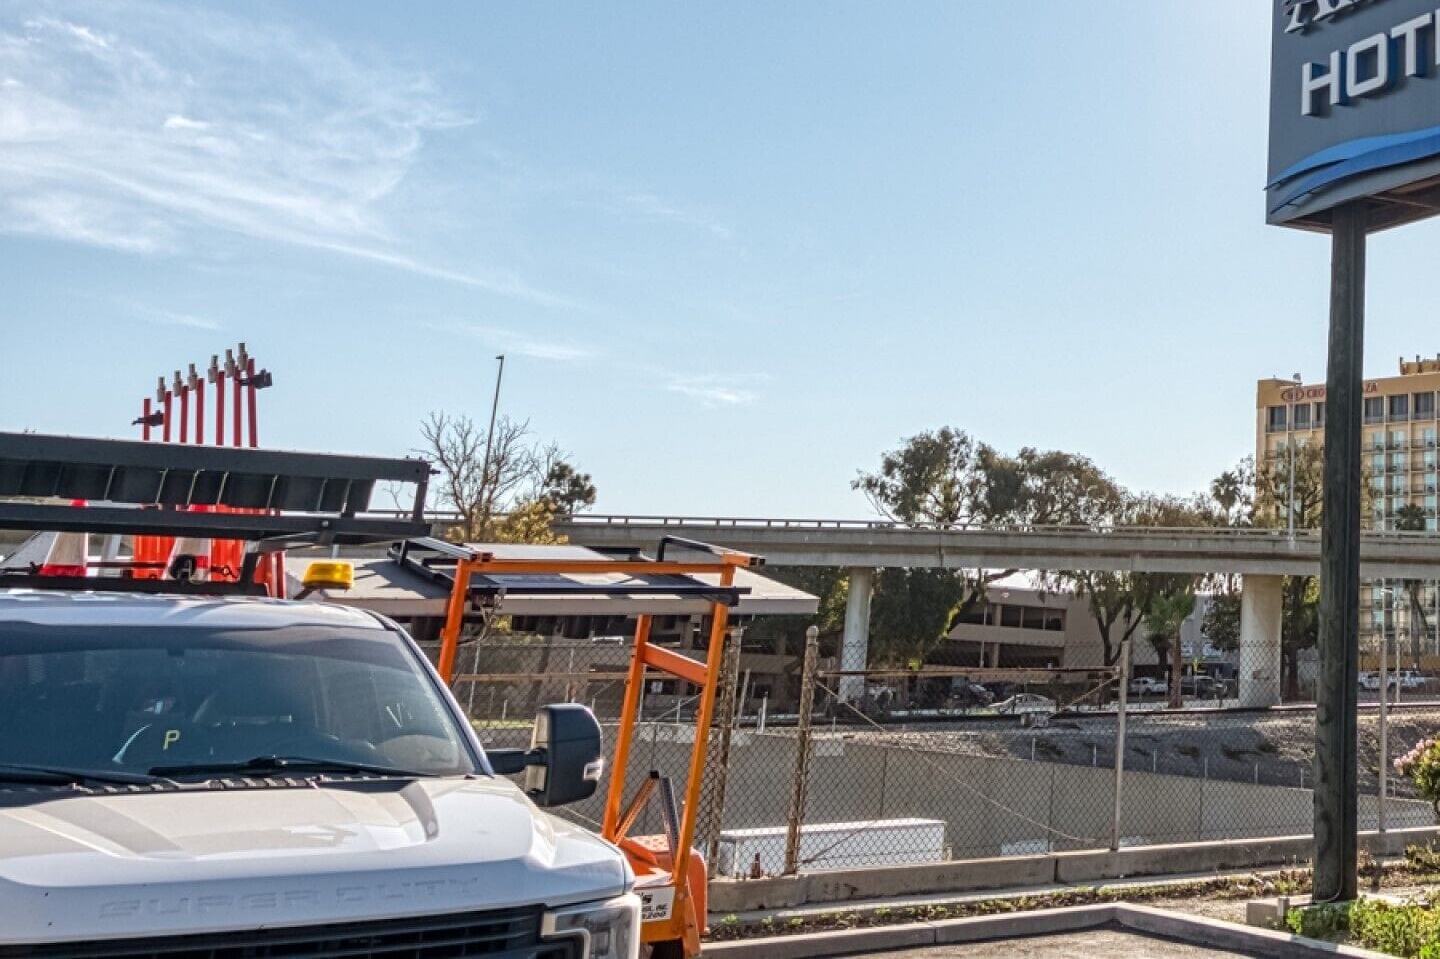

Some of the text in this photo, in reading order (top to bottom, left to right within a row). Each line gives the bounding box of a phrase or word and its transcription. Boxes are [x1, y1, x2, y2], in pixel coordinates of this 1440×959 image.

[162, 729, 181, 751] P
[99, 877, 479, 919] SUPER DUTY
